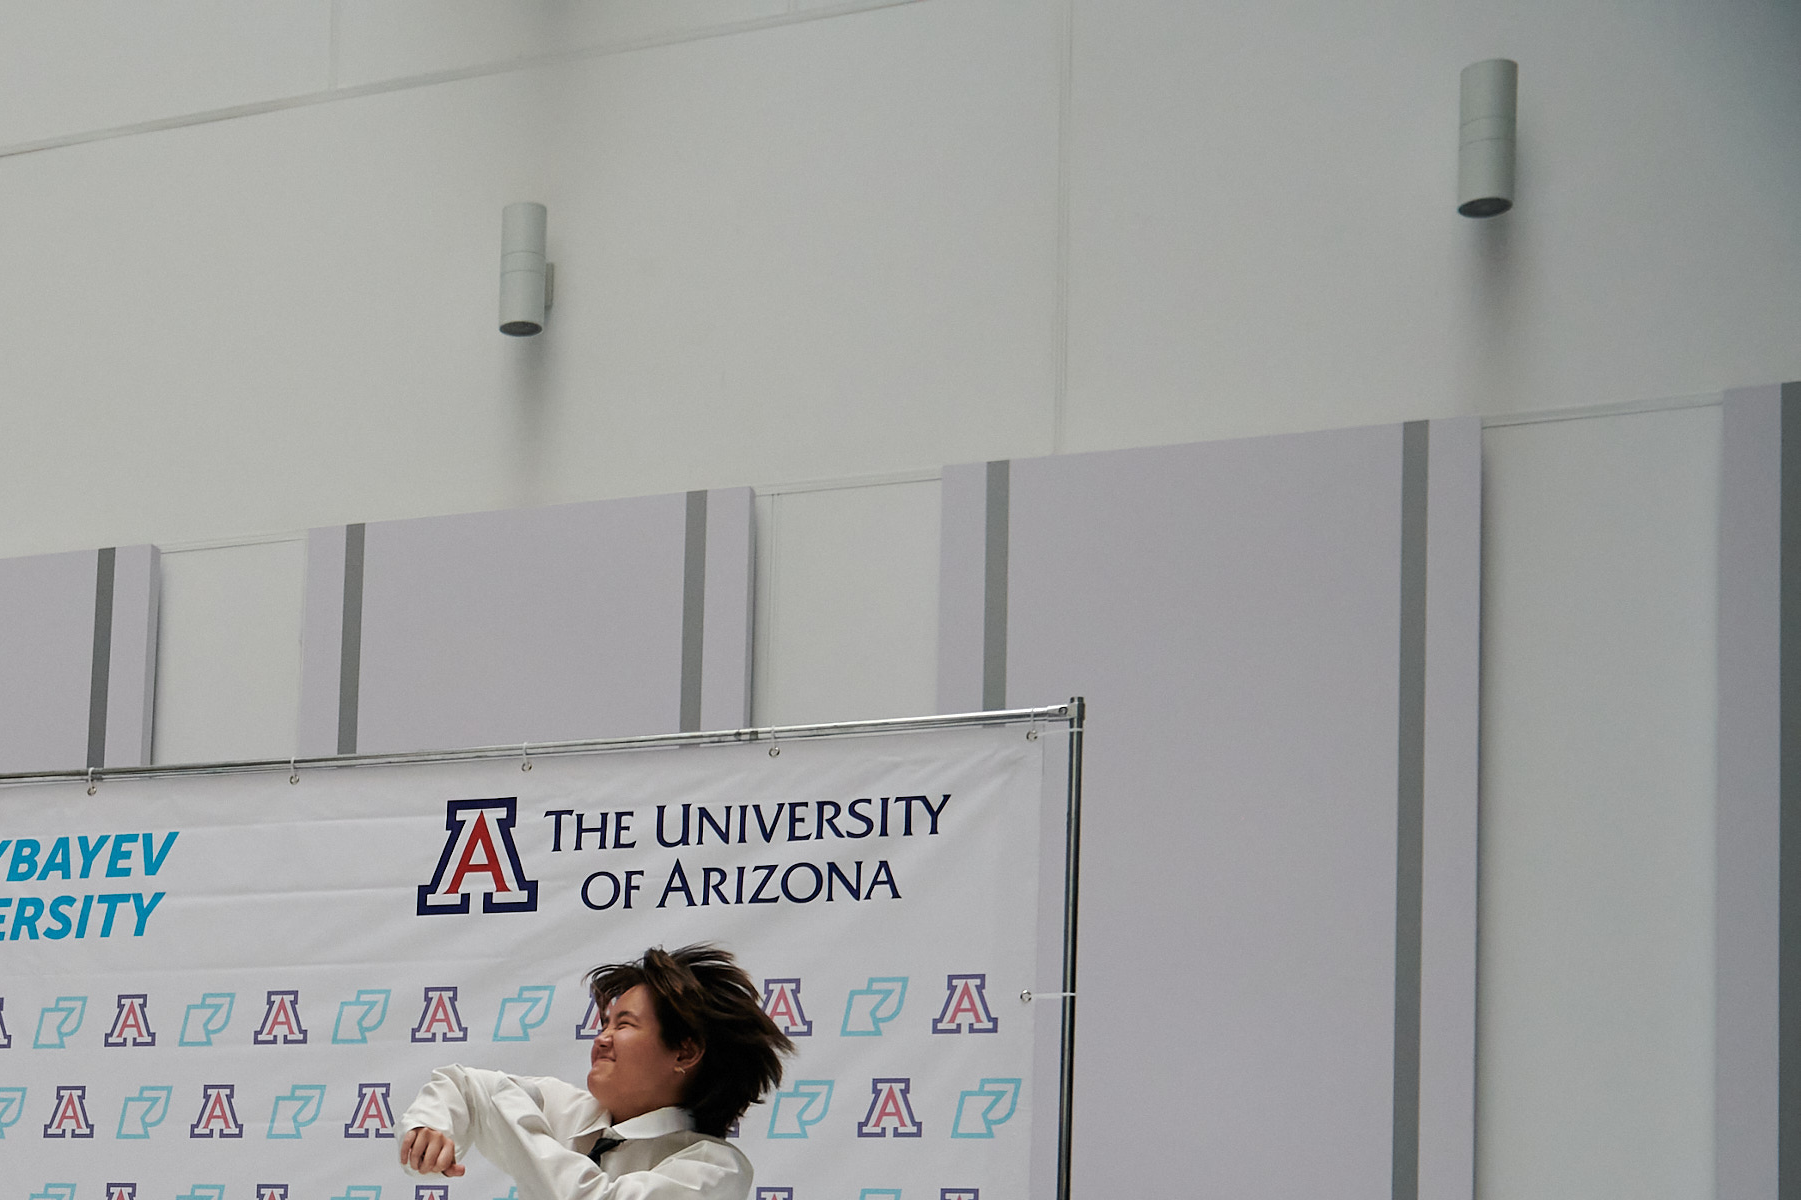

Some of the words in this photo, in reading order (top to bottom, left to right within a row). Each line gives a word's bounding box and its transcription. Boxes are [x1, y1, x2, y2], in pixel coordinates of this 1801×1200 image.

[544, 808, 637, 853] THE
[655, 793, 952, 847] UNIVERSITY
[416, 796, 539, 916] A
[580, 869, 645, 911] OF
[656, 858, 902, 909] ARIZONA
[105, 995, 155, 1046] A
[254, 991, 307, 1044] A
[411, 987, 467, 1042] A
[932, 974, 997, 1034] A
[44, 1086, 93, 1138] A
[190, 1085, 243, 1138] A
[345, 1084, 393, 1138] A
[857, 1078, 922, 1137] A
